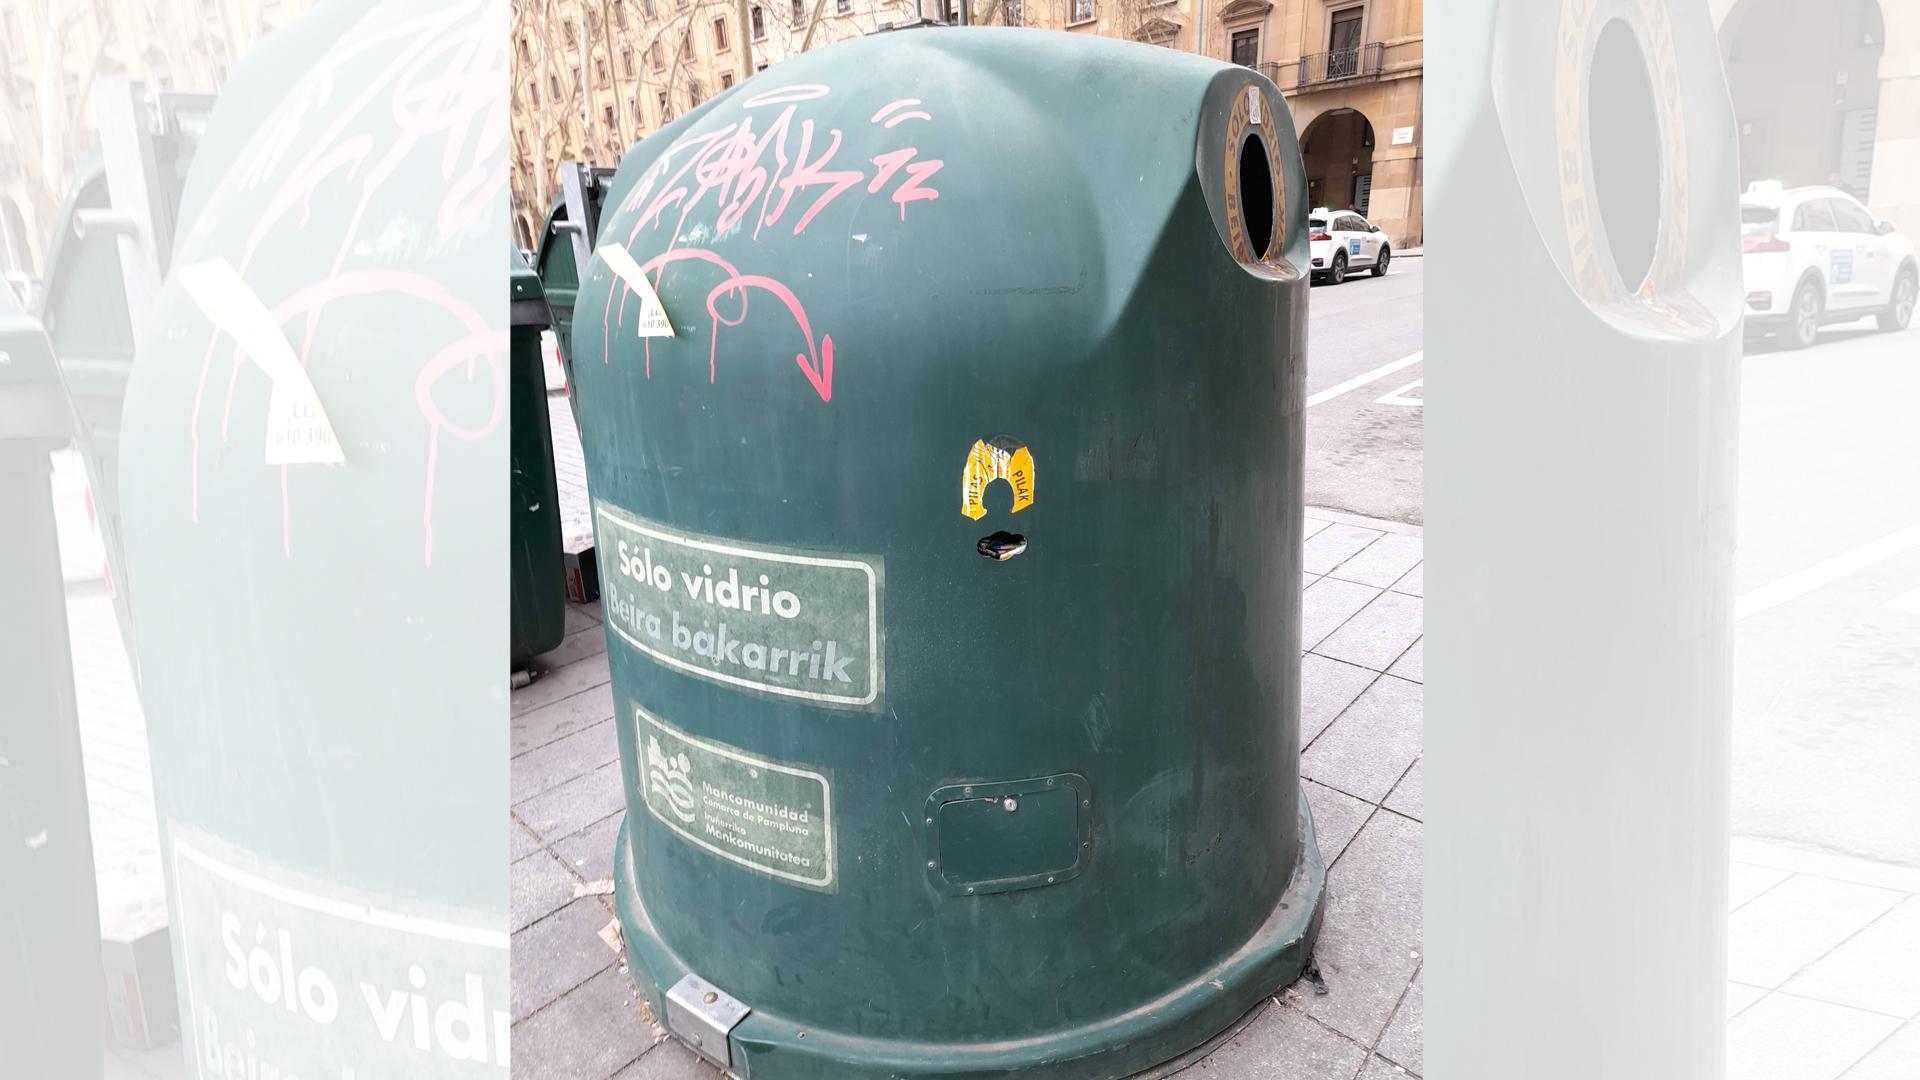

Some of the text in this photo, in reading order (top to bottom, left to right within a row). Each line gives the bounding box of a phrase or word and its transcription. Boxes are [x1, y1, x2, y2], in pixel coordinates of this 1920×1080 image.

[1012, 470, 1029, 502] PILAK
[618, 540, 801, 619] Sólo vidrio
[609, 582, 855, 683] Beira bakarrik
[702, 780, 809, 823] Mancomunidad
[703, 795, 740, 816] Comarca
[743, 810, 755, 822] de
[705, 822, 810, 867] Mankomunitatea
